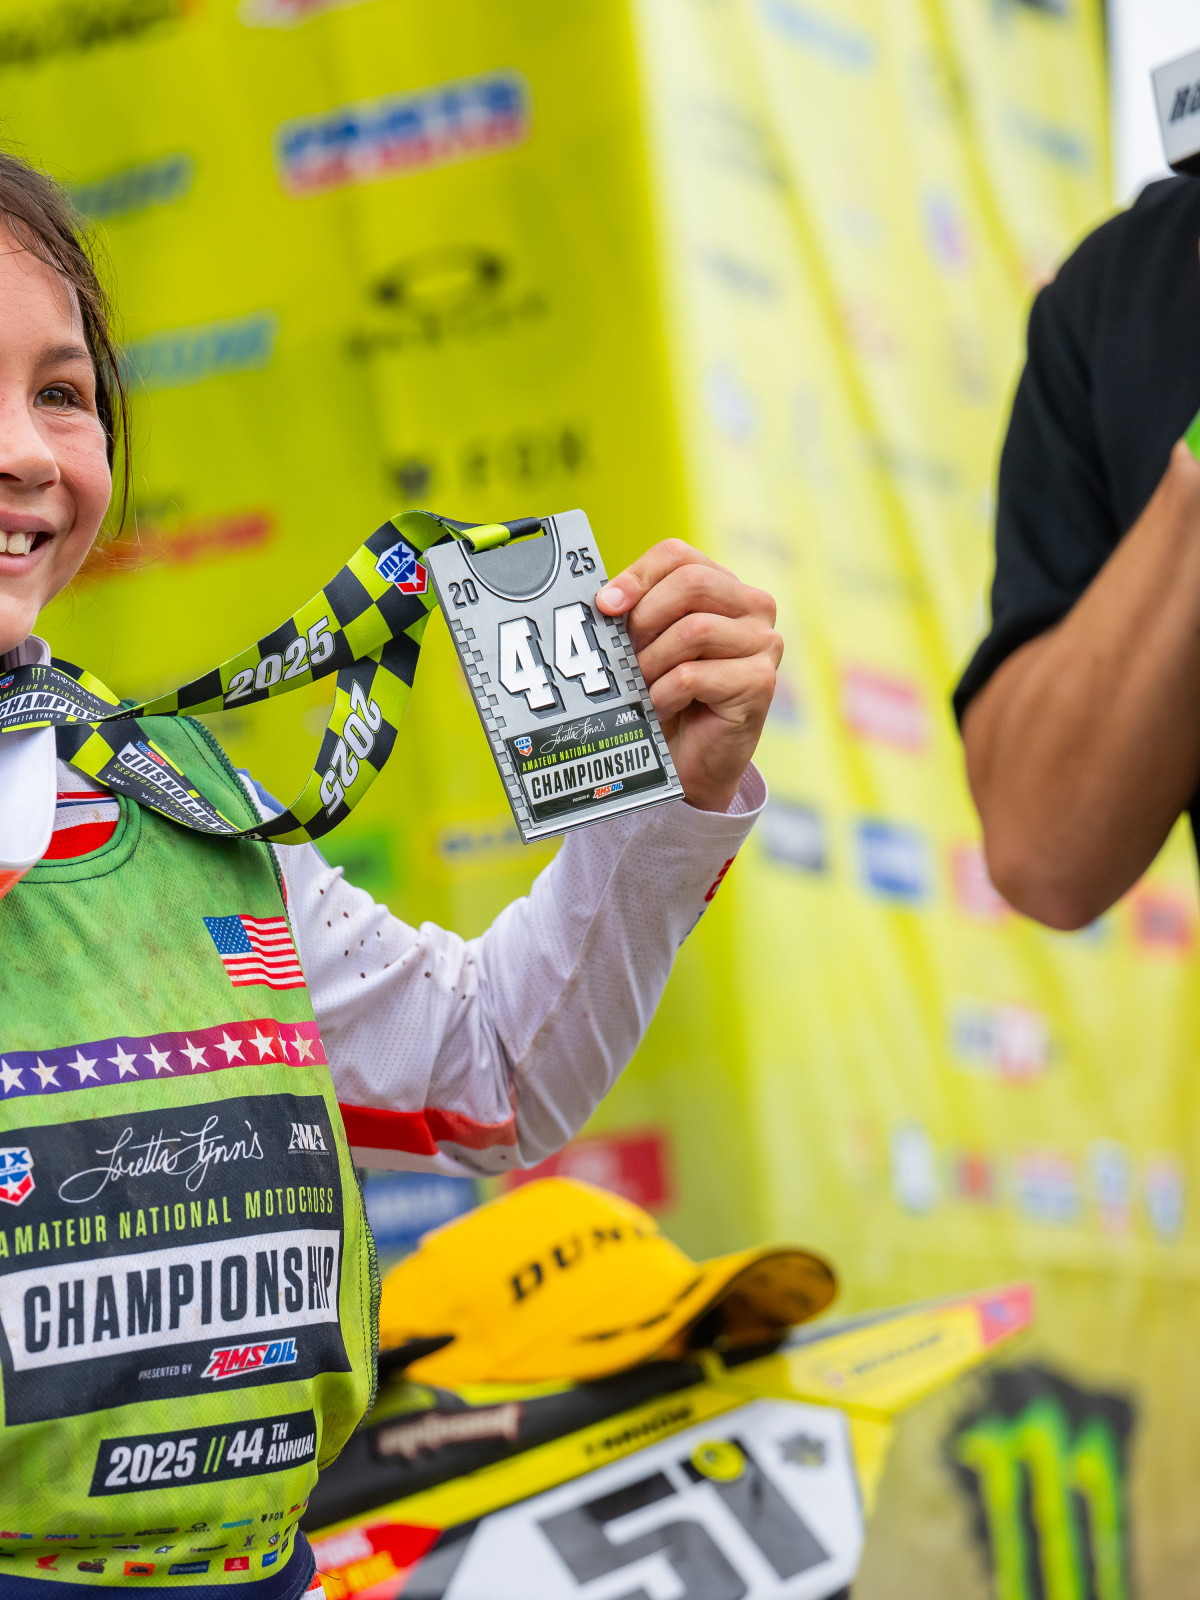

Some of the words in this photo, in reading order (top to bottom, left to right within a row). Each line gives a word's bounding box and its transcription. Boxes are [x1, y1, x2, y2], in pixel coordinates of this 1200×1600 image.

[379, 543, 411, 580] MX
[566, 547, 596, 578] 25
[448, 578, 480, 610] 20
[223, 616, 337, 703] 2025
[498, 602, 615, 714] 44
[42, 685, 84, 706] NATIONAL
[4, 715, 33, 726] LORETTA
[615, 709, 640, 727] AMA
[319, 678, 382, 818] 2025
[522, 754, 557, 772] AMATEUR
[560, 742, 596, 761] NATIONAL
[599, 728, 644, 748] MOTOCROSS
[531, 745, 650, 799] CHAMPIONSHIP
[593, 780, 623, 799] AMSOIL
[288, 1122, 329, 1151] AMA
[59, 1127, 182, 1203] Loretta
[166, 1115, 264, 1192] Lynn's
[119, 1196, 232, 1239] NATIONAL
[245, 1186, 334, 1219] MOTOCROSS
[23, 1245, 335, 1354] CHAMPIONSHIP
[138, 1365, 179, 1380] PRESENTED
[181, 1364, 193, 1374] BY
[202, 1338, 297, 1381] AMSOIL
[272, 1422, 289, 1441] TH
[104, 1438, 198, 1487] 2025
[226, 1427, 264, 1467] 44
[265, 1433, 315, 1465] ANNUAL
[268, 1511, 284, 1522] FOX
